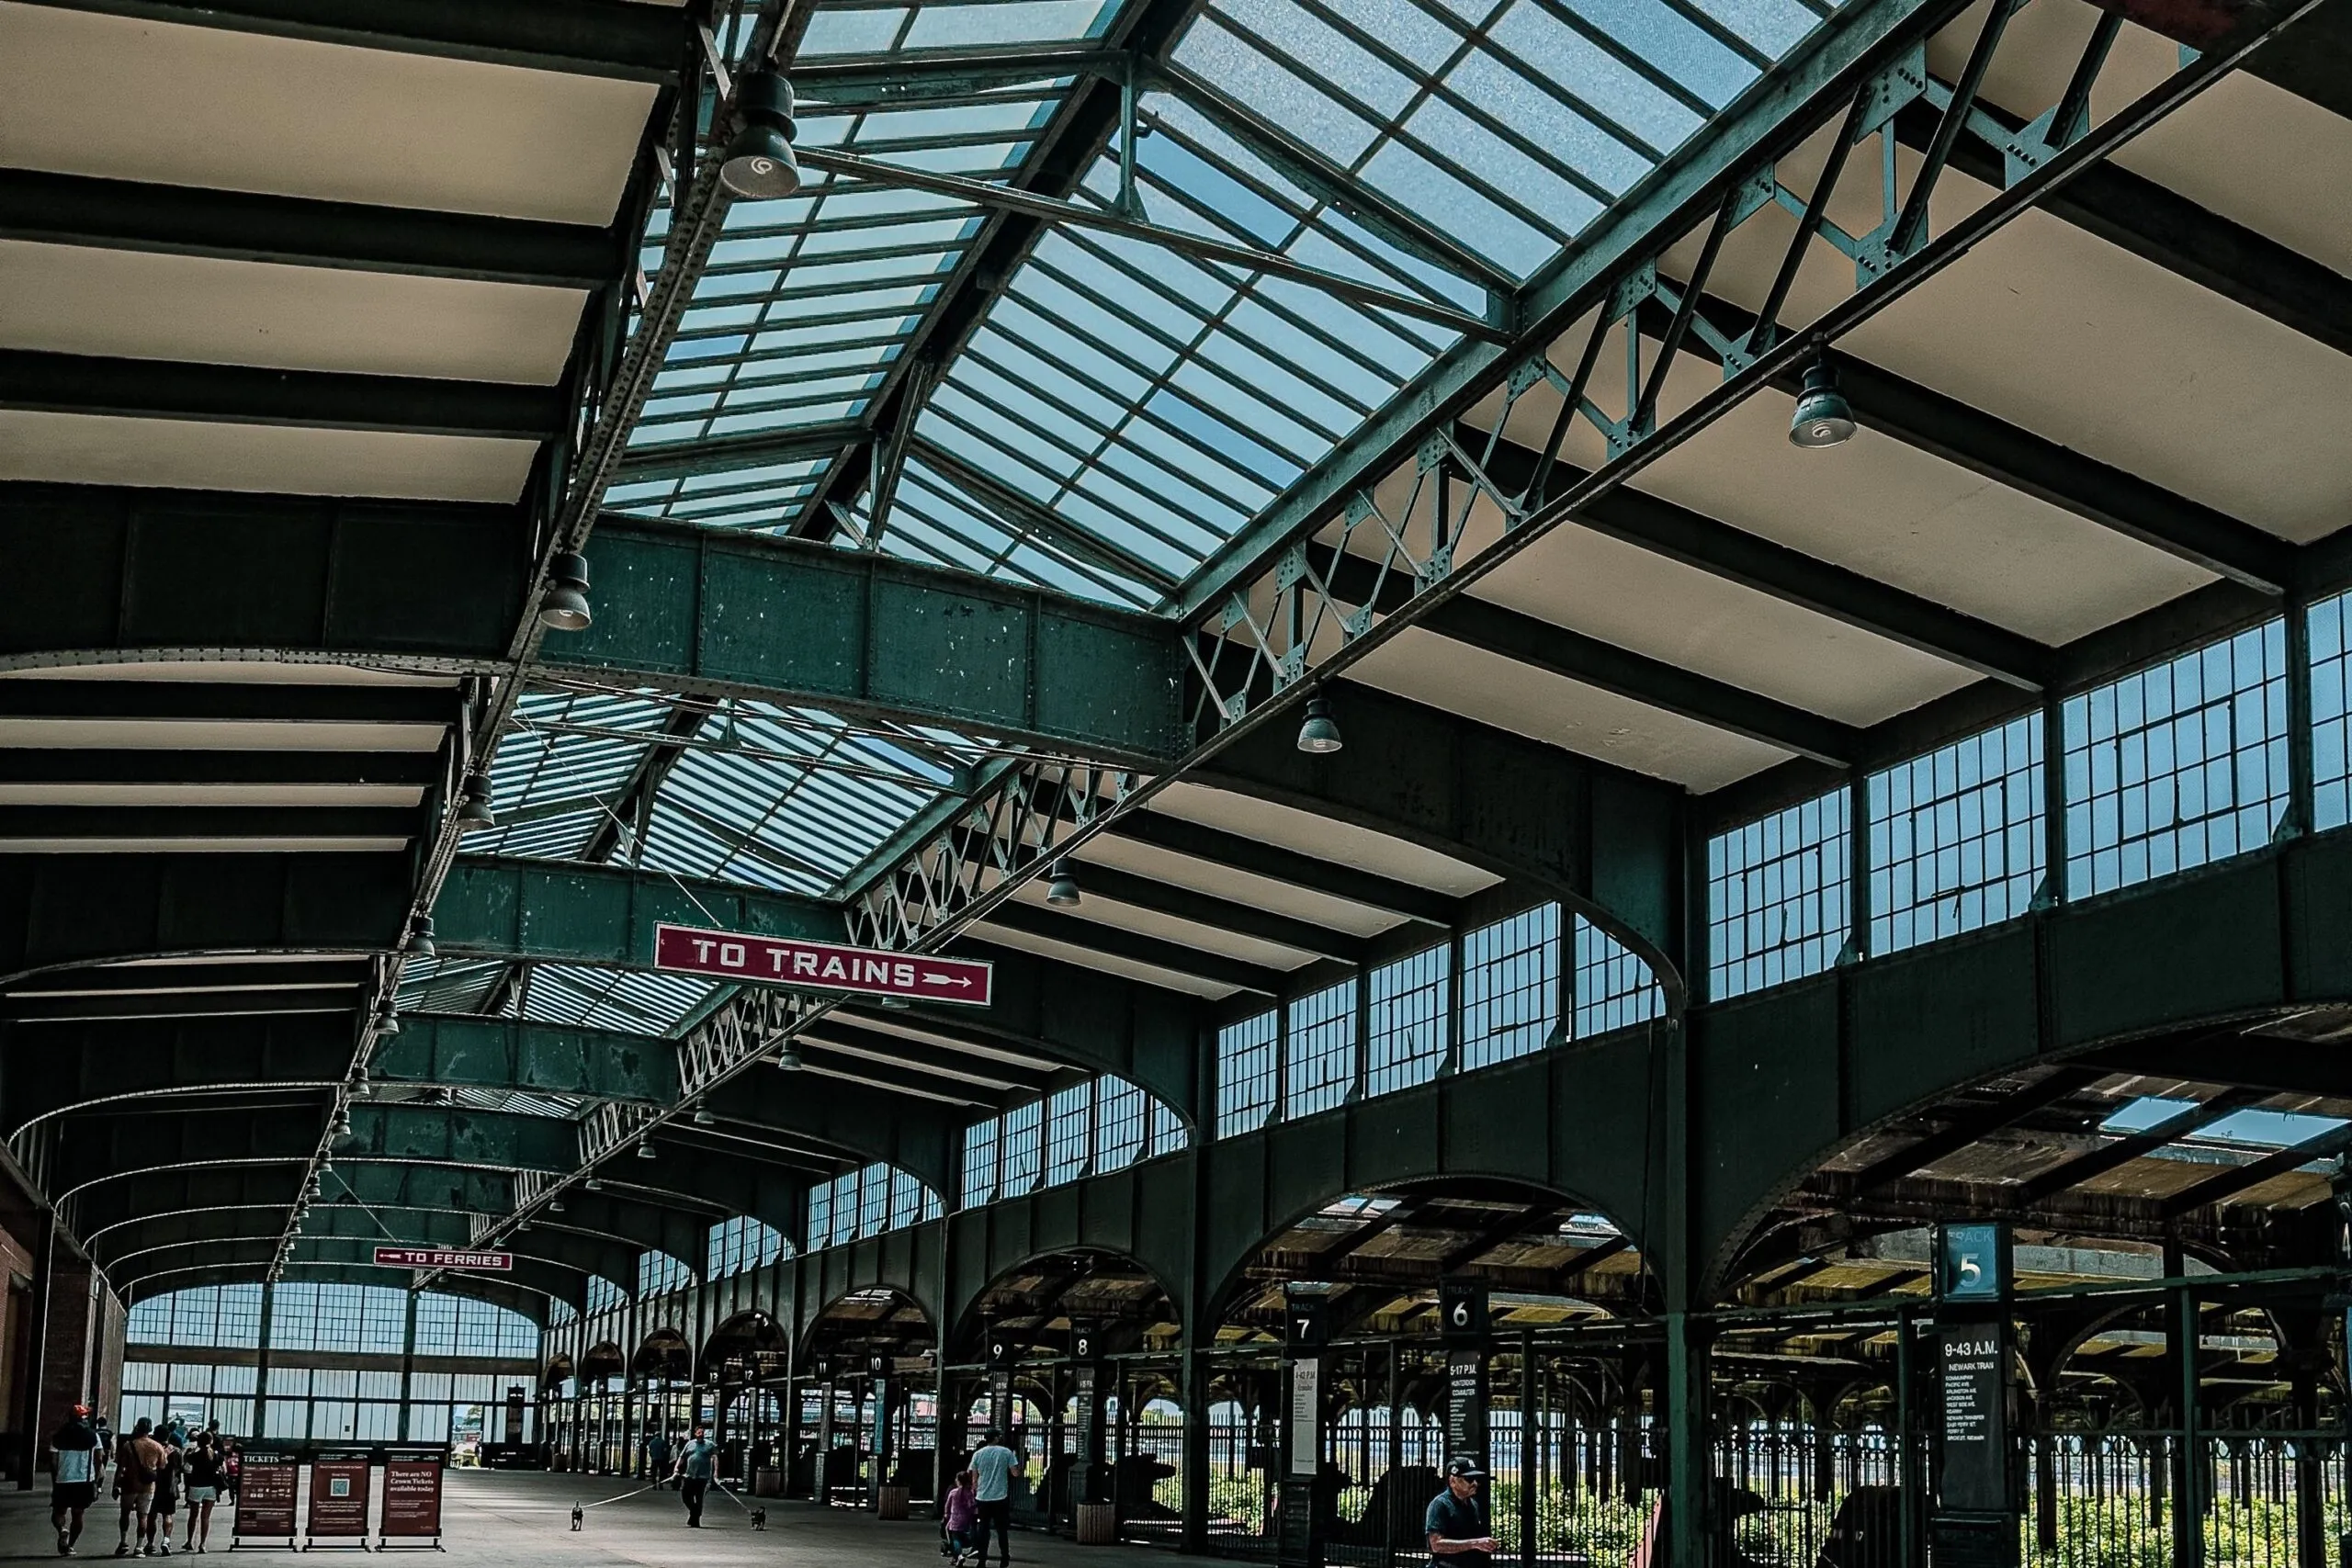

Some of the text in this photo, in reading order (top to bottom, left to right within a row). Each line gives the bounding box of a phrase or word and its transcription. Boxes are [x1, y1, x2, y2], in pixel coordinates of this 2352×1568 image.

[691, 938, 915, 987] TO TRAINS
[1947, 1230, 1992, 1243] TRACK
[405, 1252, 502, 1266] TO FERRIES
[1960, 1252, 1981, 1288] 5
[1453, 1301, 1468, 1326] 6
[1296, 1318, 1310, 1339] 7
[993, 1343, 1003, 1359] 9
[1078, 1338, 1088, 1356] 8
[1945, 1340, 1998, 1357] 9-43 A.M.
[819, 1361, 827, 1374] 11
[871, 1357, 882, 1371] 10
[1450, 1365, 1464, 1376] 5-17
[1949, 1363, 1976, 1371] NEWARK
[710, 1372, 719, 1383] 13
[745, 1370, 753, 1381] 12
[243, 1455, 280, 1463] TICKETS
